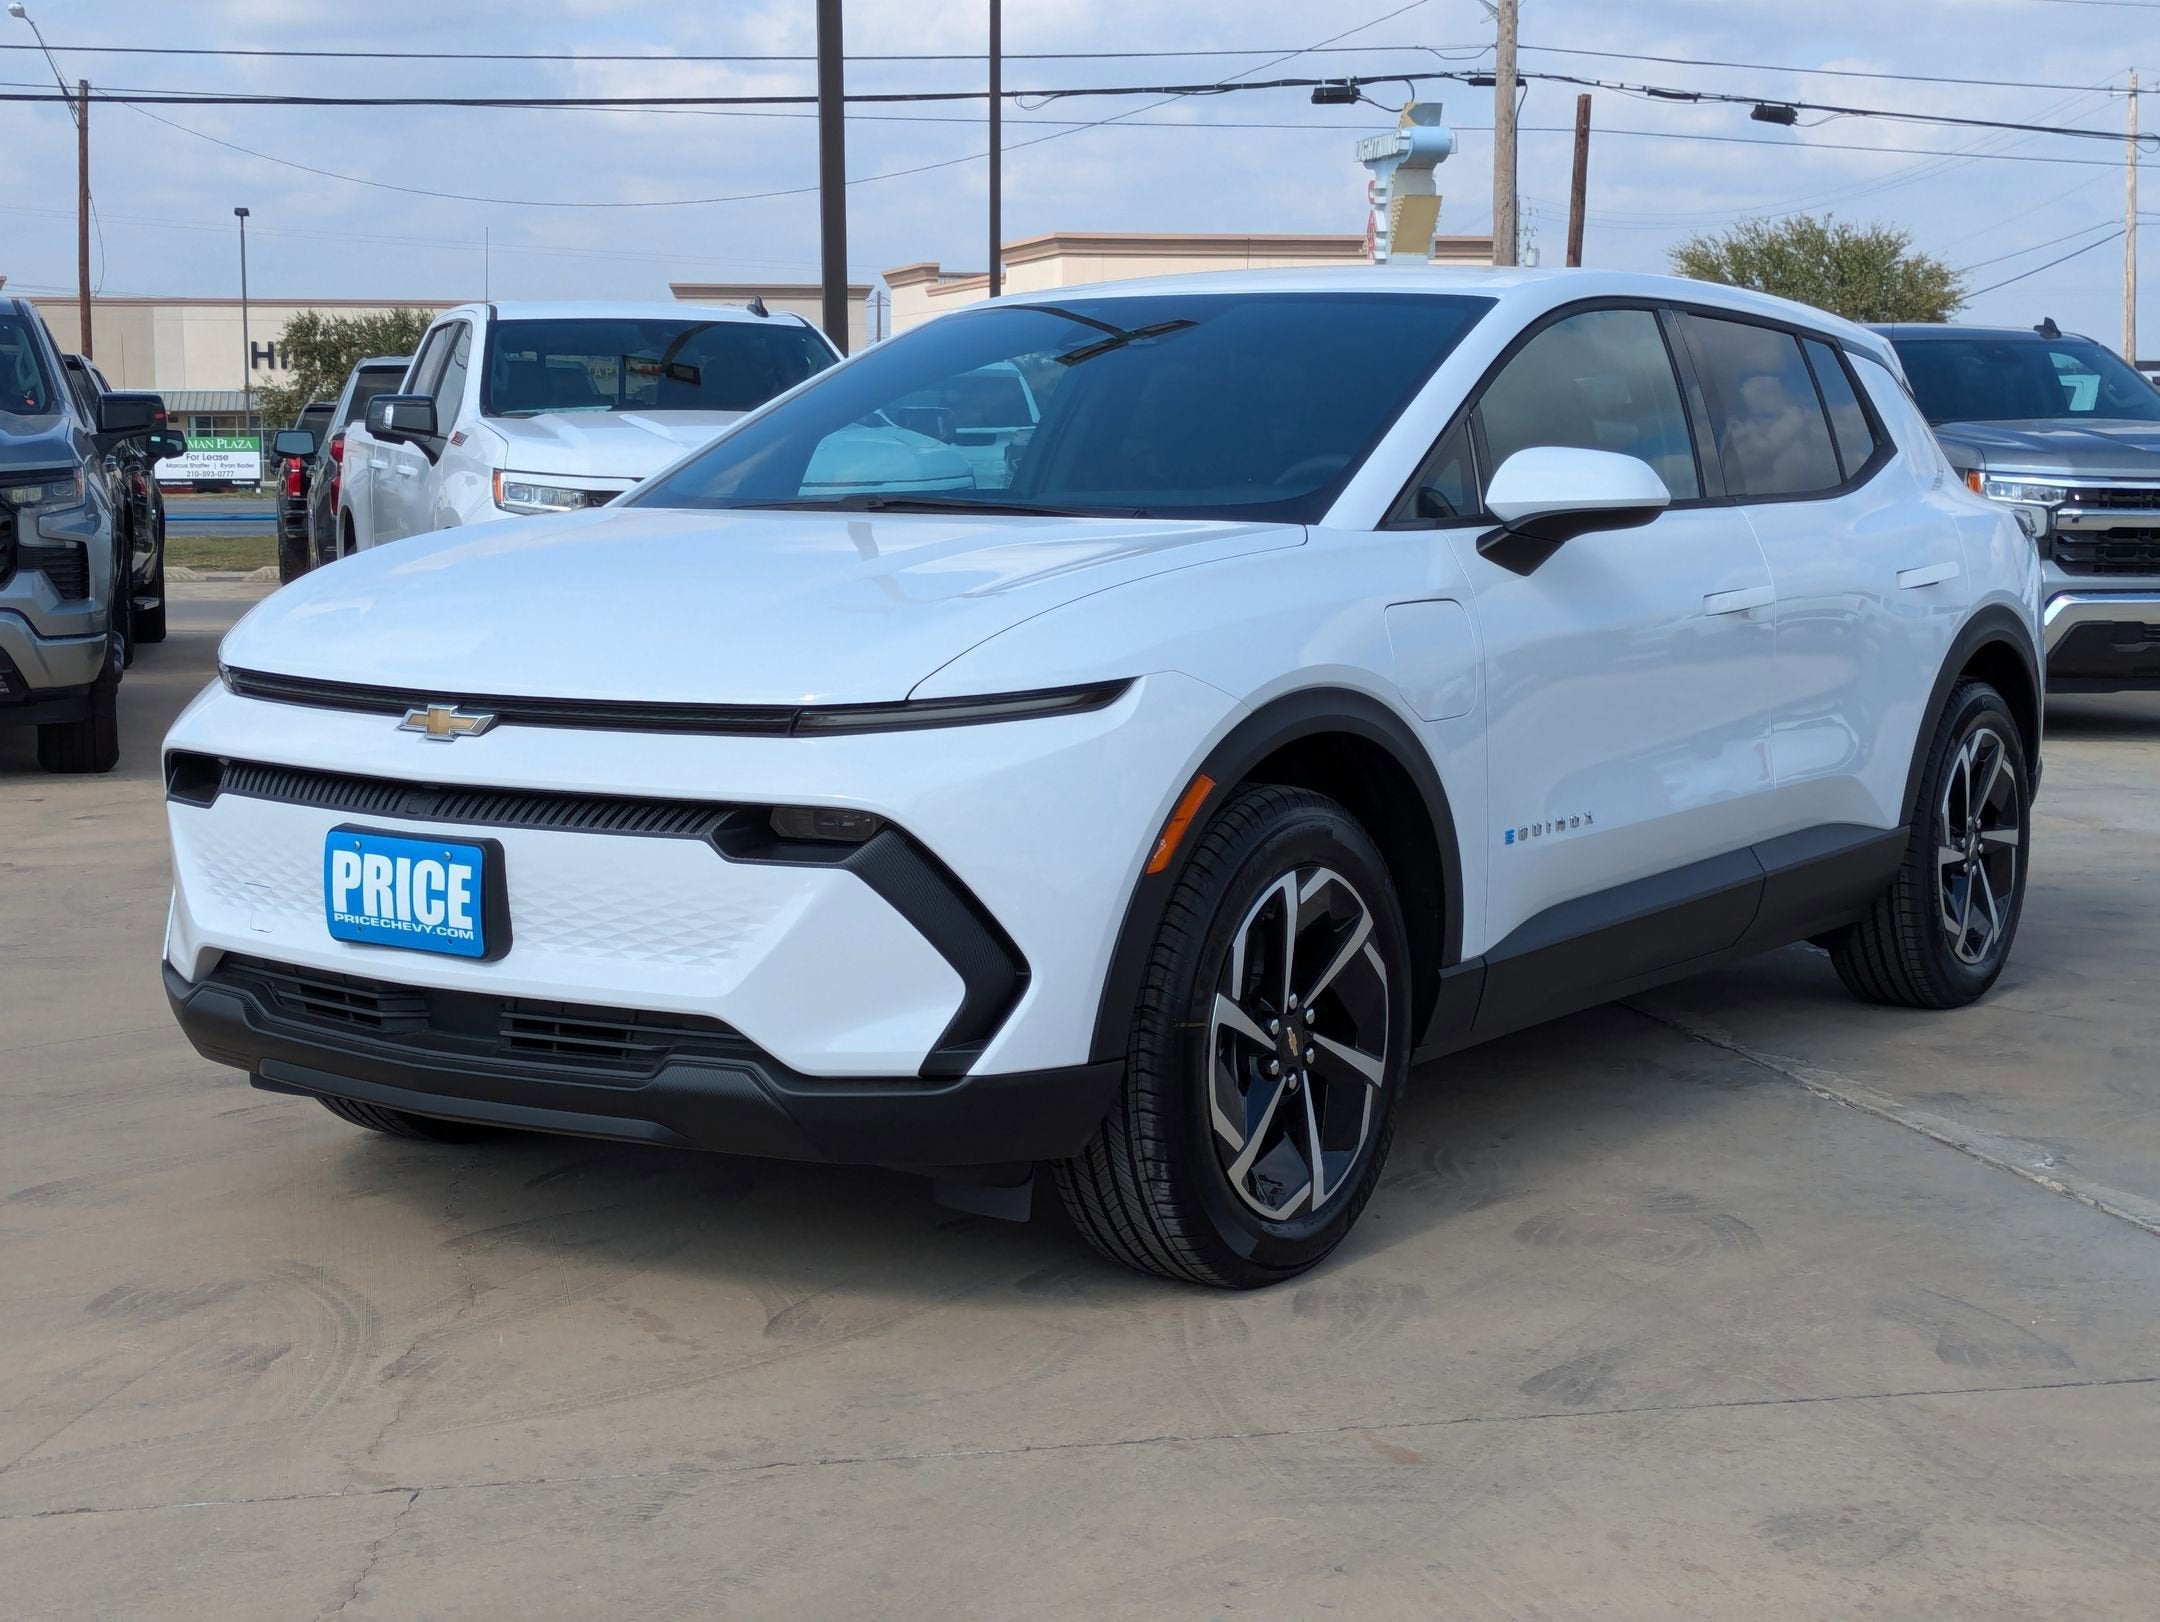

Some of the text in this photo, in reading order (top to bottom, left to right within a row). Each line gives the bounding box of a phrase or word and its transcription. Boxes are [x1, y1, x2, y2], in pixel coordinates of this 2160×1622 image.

[217, 438, 253, 449] PLAZA
[185, 453, 229, 461] For Lease
[220, 462, 236, 470] Ryan
[186, 470, 235, 478] 210-593-0777
[1504, 810, 1594, 846] EQUINOX
[332, 850, 473, 930] PRICE
[333, 912, 475, 940] PRICECHEVY.COM
